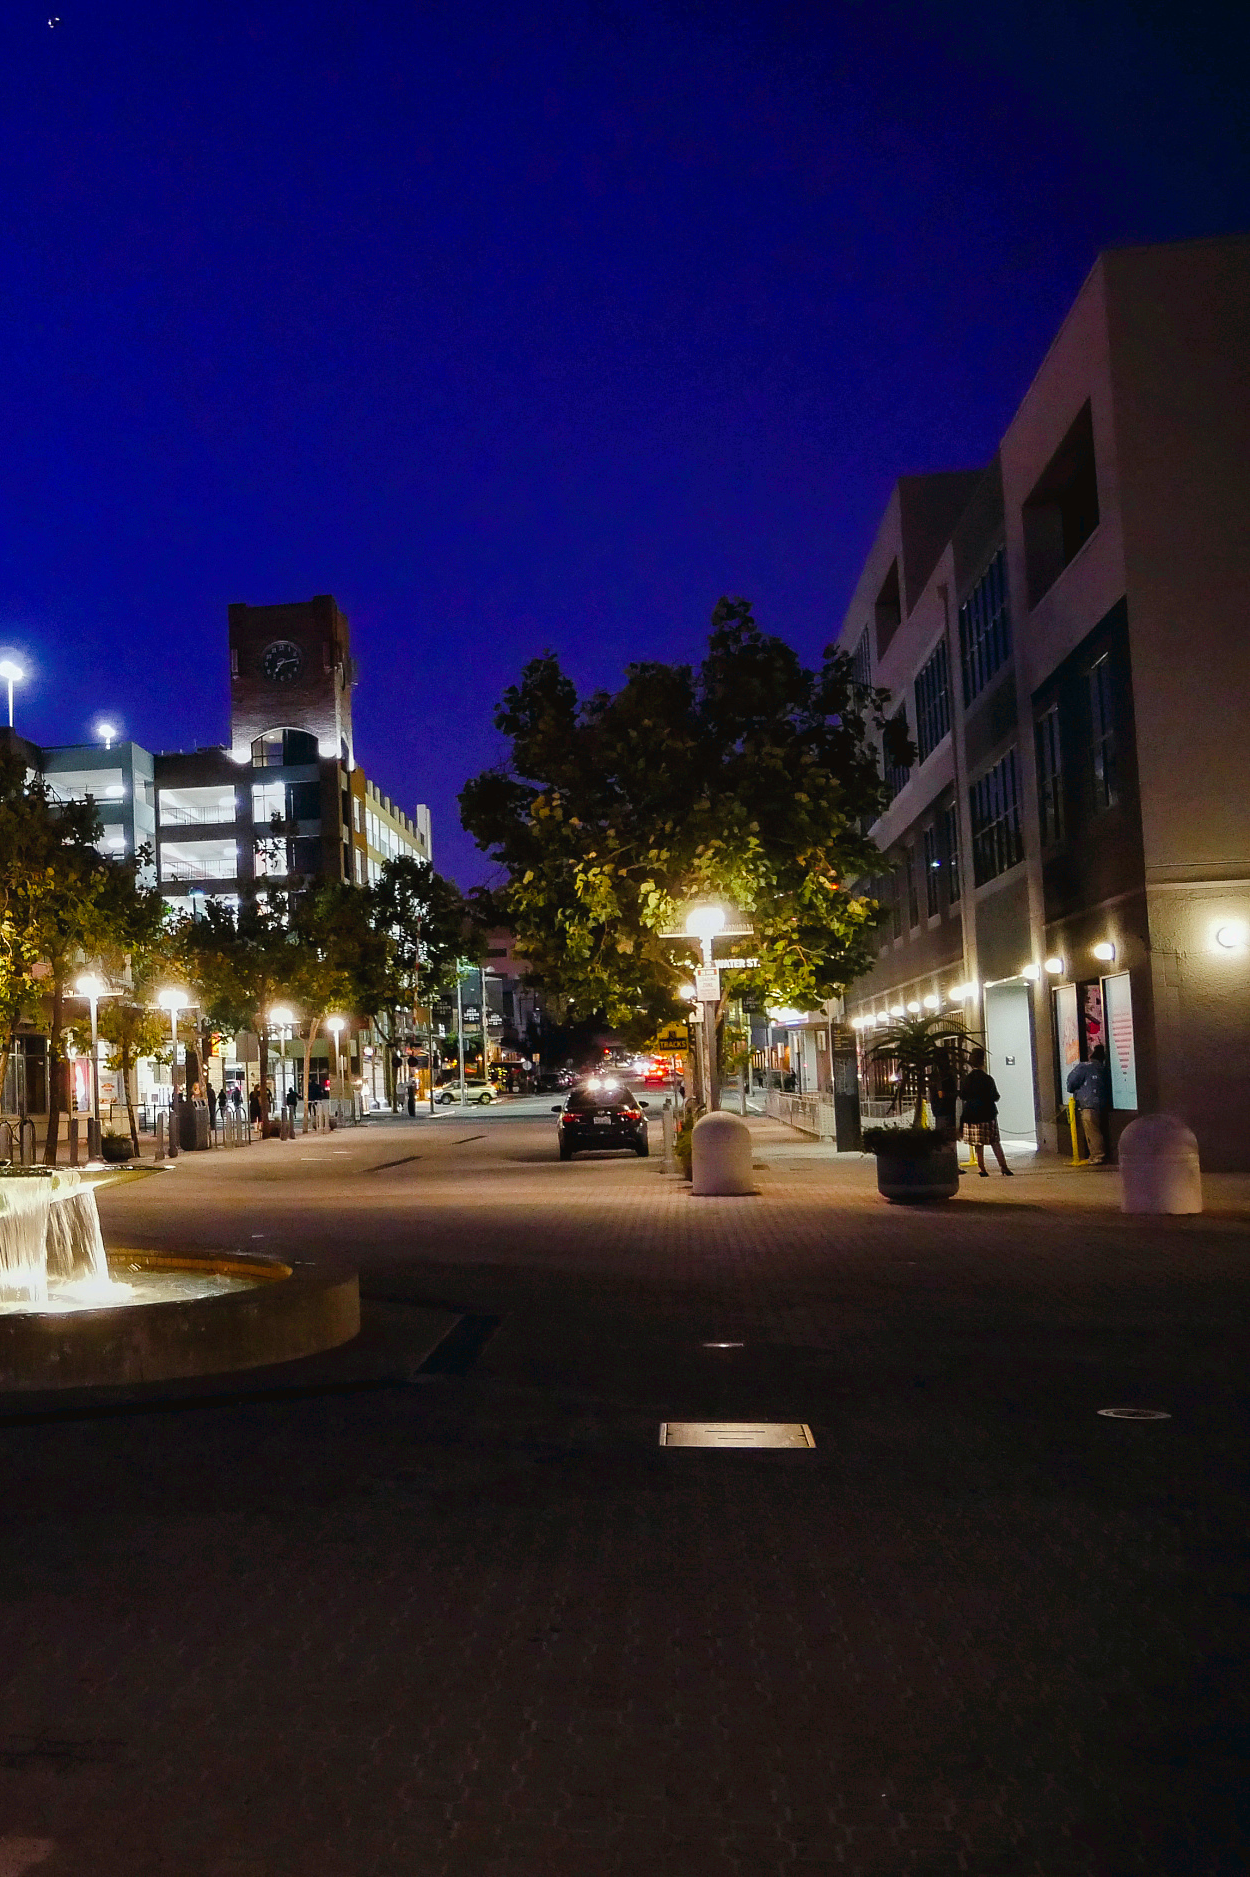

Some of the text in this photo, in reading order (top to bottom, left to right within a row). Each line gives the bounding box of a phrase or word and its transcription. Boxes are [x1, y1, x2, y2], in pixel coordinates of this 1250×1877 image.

[714, 958, 761, 969] WATER ST.
[659, 1040, 686, 1049] TRACKS
